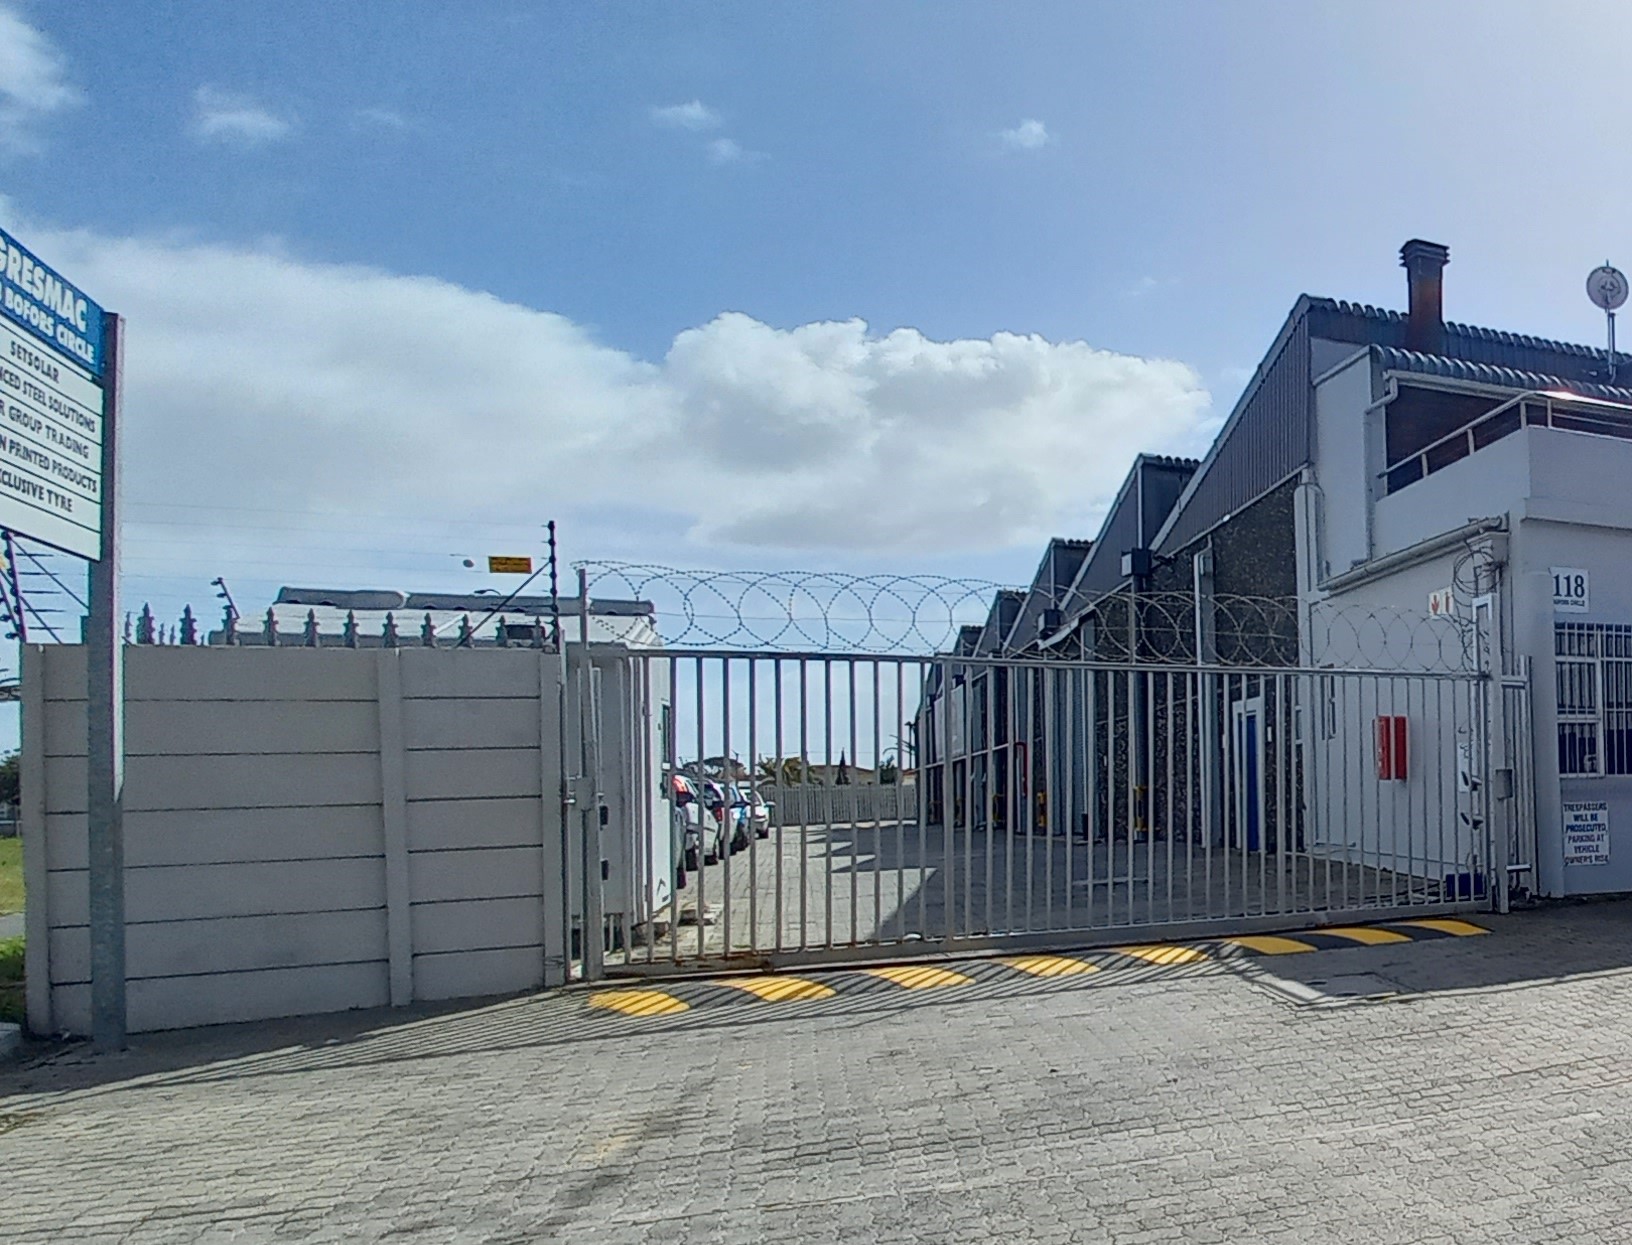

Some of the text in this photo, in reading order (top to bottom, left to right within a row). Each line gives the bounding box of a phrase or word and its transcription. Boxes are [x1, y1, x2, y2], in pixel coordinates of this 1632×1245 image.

[5, 287, 54, 338] BOFORS
[56, 324, 95, 365] CIRCLE
[10, 339, 60, 385] SETSOLAR
[22, 380, 48, 407] STEEL
[48, 394, 96, 433] SOLUTIONS
[8, 405, 43, 435] GROUP
[45, 423, 90, 460] TRADING
[9, 438, 50, 471] PRINTED
[52, 458, 98, 493] PRODUCTS
[47, 488, 73, 513] TYRE
[1553, 574, 1585, 598] 118
[1563, 803, 1607, 812] TRESPASSERS
[1573, 813, 1589, 822] WILL
[1568, 834, 1604, 844] PARKING AT
[1574, 844, 1600, 854] VEHICLE
